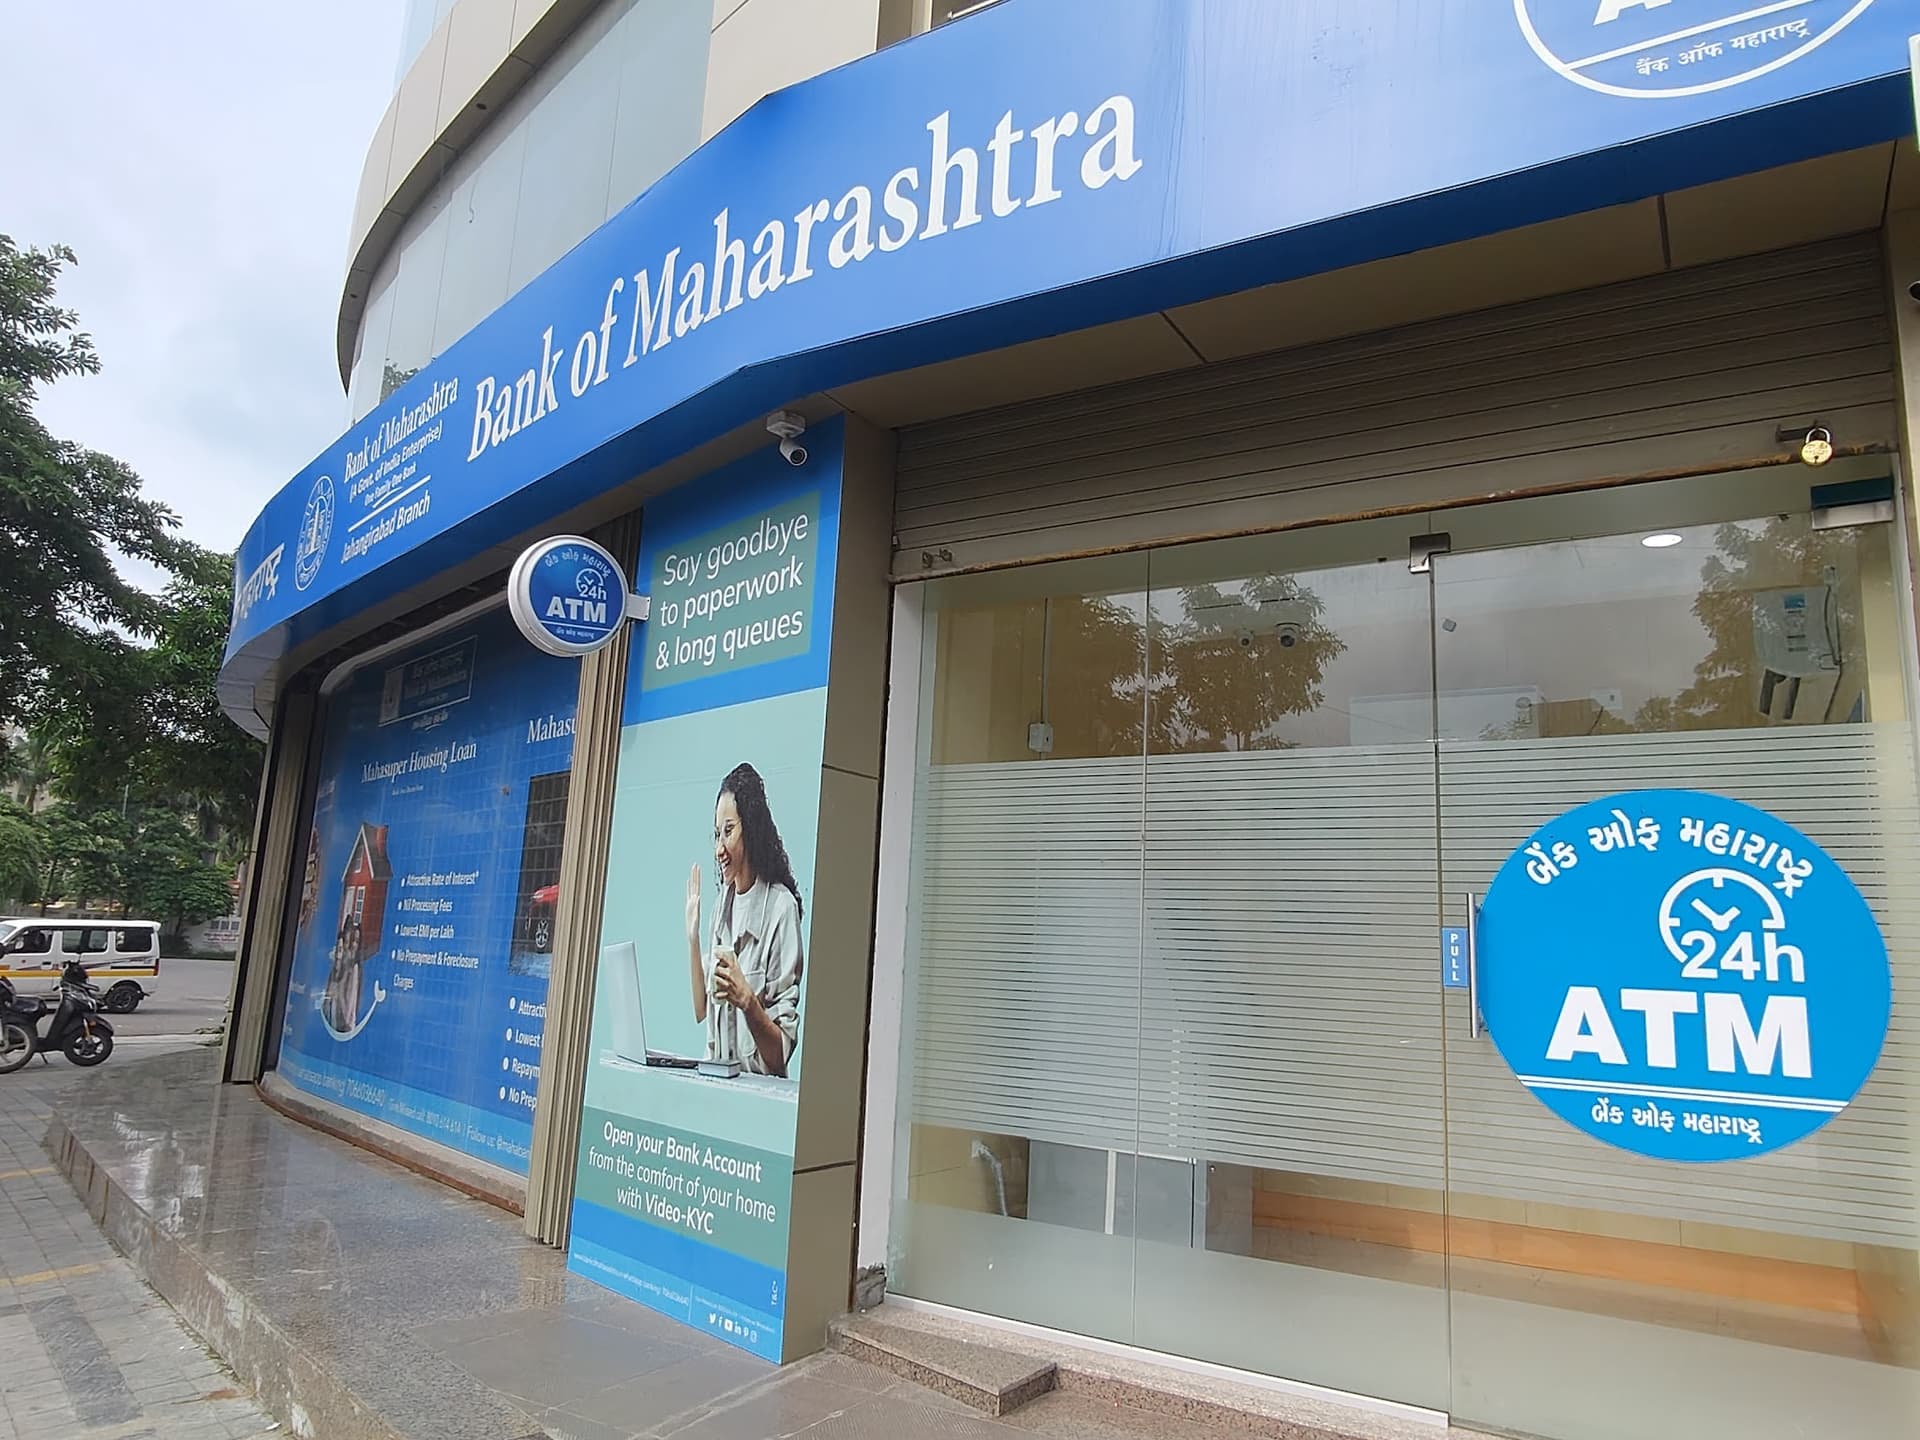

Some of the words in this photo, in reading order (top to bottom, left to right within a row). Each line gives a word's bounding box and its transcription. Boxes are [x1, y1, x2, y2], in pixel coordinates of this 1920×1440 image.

[1636, 56, 1671, 77] बैंक
[1678, 41, 1724, 67] ऑफ
[1730, 17, 1813, 51] महाराष्ट्र
[467, 325, 564, 463] Bank
[570, 277, 624, 398] of
[623, 95, 1144, 369] Maharashtra
[344, 436, 370, 484] Bank
[370, 423, 385, 463] of
[382, 377, 458, 454] Maharashtra
[375, 462, 384, 481] of
[383, 452, 400, 476] India
[401, 419, 442, 463] Enterprise)
[397, 489, 430, 530] Branch
[663, 552, 702, 586] Say
[707, 513, 809, 580] goodbye
[546, 596, 607, 624] ATM
[579, 585, 607, 600] 24h
[660, 600, 678, 627] to
[683, 555, 804, 629] paperwork
[655, 641, 670, 670] &
[674, 635, 717, 666] long
[722, 610, 804, 660] queues
[361, 759, 408, 783] Mahasuper
[409, 748, 449, 773] Housing
[450, 741, 477, 764] Loan
[406, 873, 431, 887] Attractive
[432, 873, 444, 885] Rate
[445, 870, 452, 885] of
[1525, 840, 1580, 886] બેંક
[1587, 809, 1660, 852] ઓફ
[1679, 816, 1814, 899] મહારાષ્ટ્ર
[403, 898, 412, 911] Nil
[411, 898, 439, 915] Processing
[440, 898, 453, 912] Fees
[399, 924, 418, 937] Lowest
[418, 924, 430, 937] EMI
[430, 928, 440, 941] per
[440, 925, 455, 939] Lakh
[1680, 931, 1806, 983] 24h
[393, 973, 414, 990] Charges
[396, 948, 404, 961] No
[405, 949, 437, 966] Prepayment
[437, 951, 443, 965] &
[444, 952, 479, 969] Foreclosure
[1450, 933, 1459, 983] PULL
[515, 1029, 541, 1048] Lowest
[1545, 985, 1812, 1079] ATM
[508, 1087, 519, 1104] No
[1591, 1097, 1624, 1124] બેંક
[1632, 1102, 1675, 1132] ઓફ
[1683, 1112, 1763, 1144] મહારાષ્ટ્ર
[604, 1121, 634, 1148] Open
[636, 1132, 664, 1156] your
[666, 1137, 700, 1166] Bank
[702, 1147, 762, 1183] Account
[589, 1146, 614, 1172] from
[616, 1155, 634, 1179] the
[636, 1164, 683, 1194] comfort
[686, 1178, 700, 1201] of
[700, 1188, 733, 1210] your
[735, 1188, 776, 1224] home
[617, 1186, 641, 1210] with
[645, 1191, 714, 1235] Video-KYC
